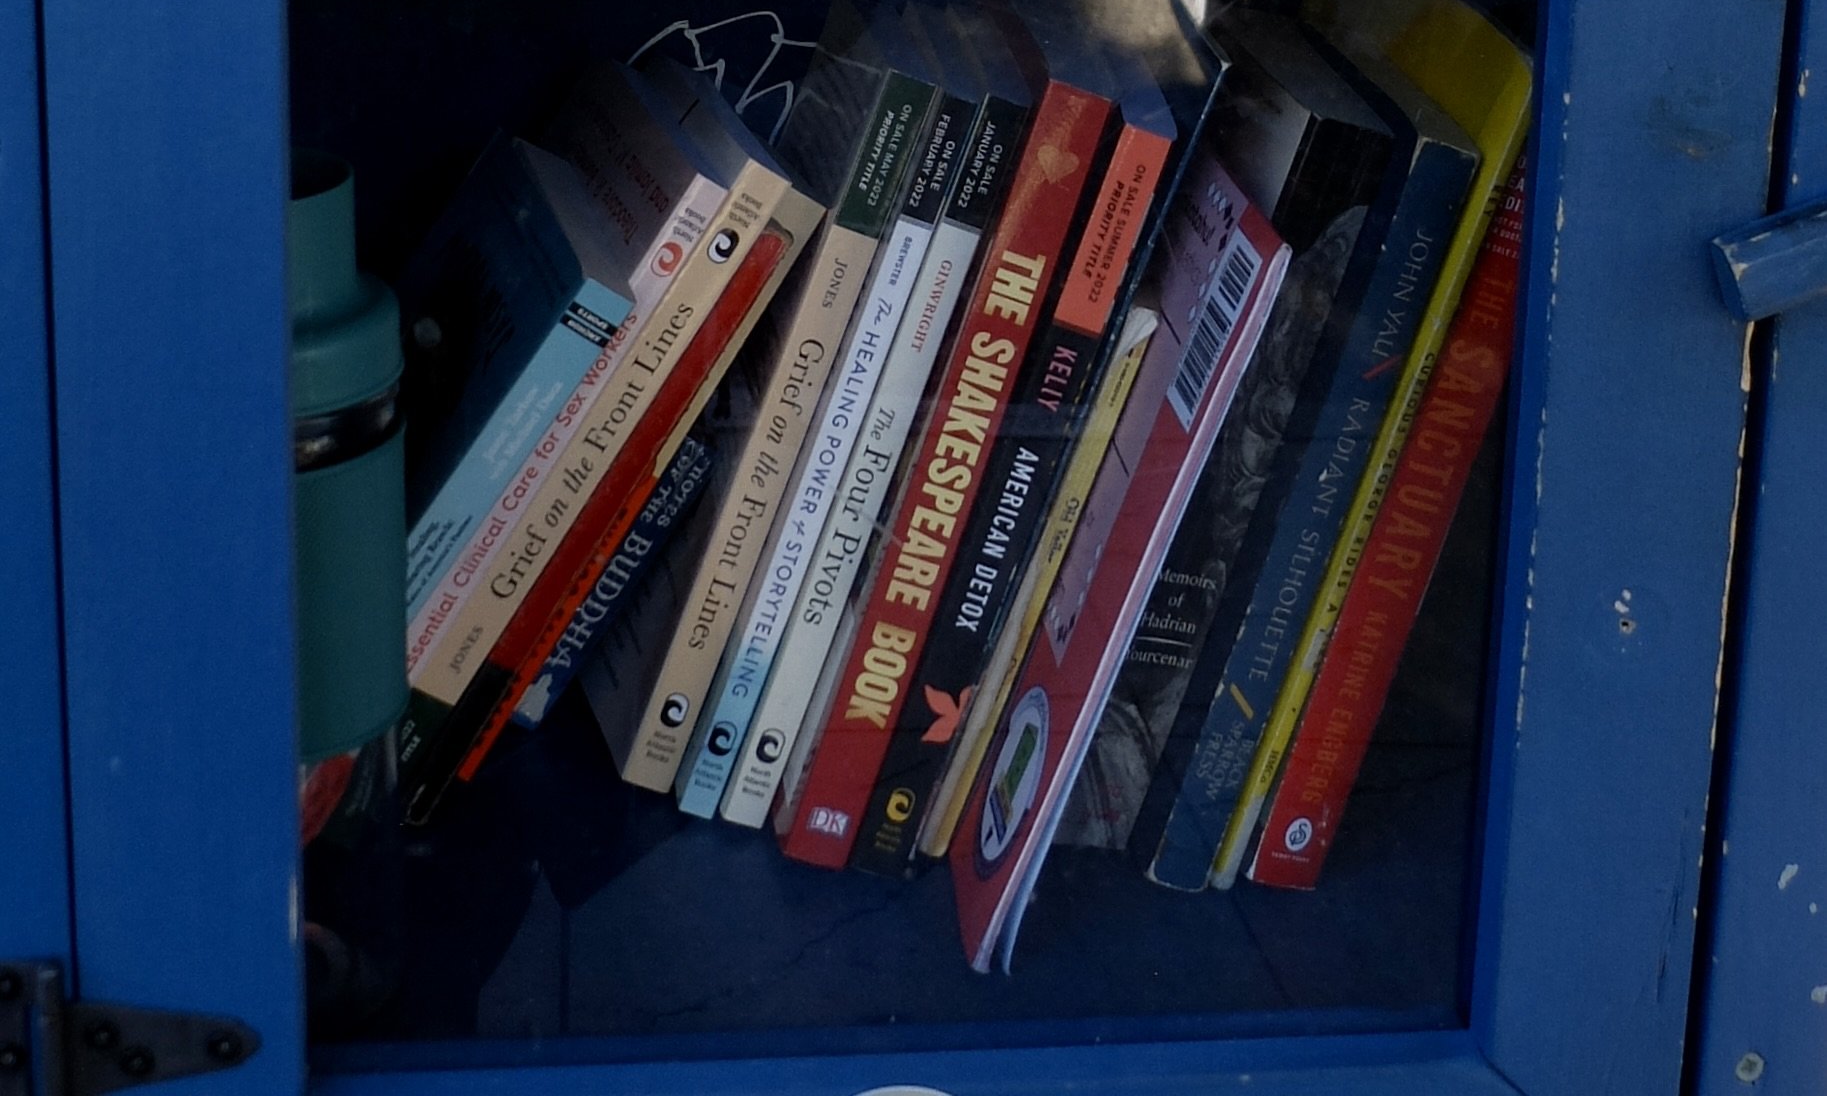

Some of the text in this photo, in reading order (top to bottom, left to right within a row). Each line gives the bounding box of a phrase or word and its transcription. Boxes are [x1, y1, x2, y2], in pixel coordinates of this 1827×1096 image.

[858, 109, 896, 193] PRIORITY TITLE
[867, 104, 913, 207] ON SALE MAY 2022
[909, 114, 951, 208] FEBRUARY 2022
[930, 140, 956, 192] ON SALE
[957, 120, 996, 209] JANUARY 2022
[978, 143, 1003, 196] ON SALE
[887, 235, 913, 288] BREWSTER
[1082, 181, 1125, 279] PRIORITY TITLE
[1088, 164, 1146, 305] ON SALE SUMMER 2022
[1392, 229, 1433, 299] JOHN
[865, 297, 892, 327] The
[1372, 303, 1405, 358] YAU
[1477, 270, 1515, 328] THE
[827, 333, 883, 430] HEALING
[1400, 352, 1436, 433] CURIOUS
[453, 515, 509, 584] Clinical
[502, 465, 540, 515] Care
[532, 426, 563, 463] for
[556, 389, 589, 429] Sex
[583, 312, 639, 389] Workers
[491, 522, 552, 600] Grief
[545, 487, 571, 529] on
[563, 453, 598, 497] the
[585, 372, 644, 454] Front
[633, 303, 696, 379] Lines
[688, 257, 849, 652] JONES Grief on the Front Lines
[799, 431, 840, 517] POWER
[803, 259, 954, 626] GINWRIGHT The Four Pivots
[1312, 395, 1369, 520] RADIANT
[1370, 338, 1492, 604] SANCTUARY
[845, 249, 1047, 729] THE SHAKESPEARE BOOK
[955, 344, 1078, 633] KELLY AMERICAN DETOX
[1364, 448, 1398, 524] GEORGE
[545, 532, 653, 672] BUDDHA
[1158, 569, 1216, 591] Memoirs
[1168, 592, 1183, 608] of
[1336, 536, 1366, 588] RIDES
[449, 624, 484, 673] JONES
[730, 536, 805, 698] STORYTELLING
[1141, 612, 1197, 635] Hadrian
[1248, 529, 1320, 682] SILHOUETTE
[1325, 603, 1337, 614] A
[1338, 608, 1389, 703] KATRINE
[1204, 721, 1243, 801] SPARROW
[1228, 739, 1254, 788] BLACK
[1303, 705, 1354, 803] ENGBERG
[808, 807, 849, 834] DK
